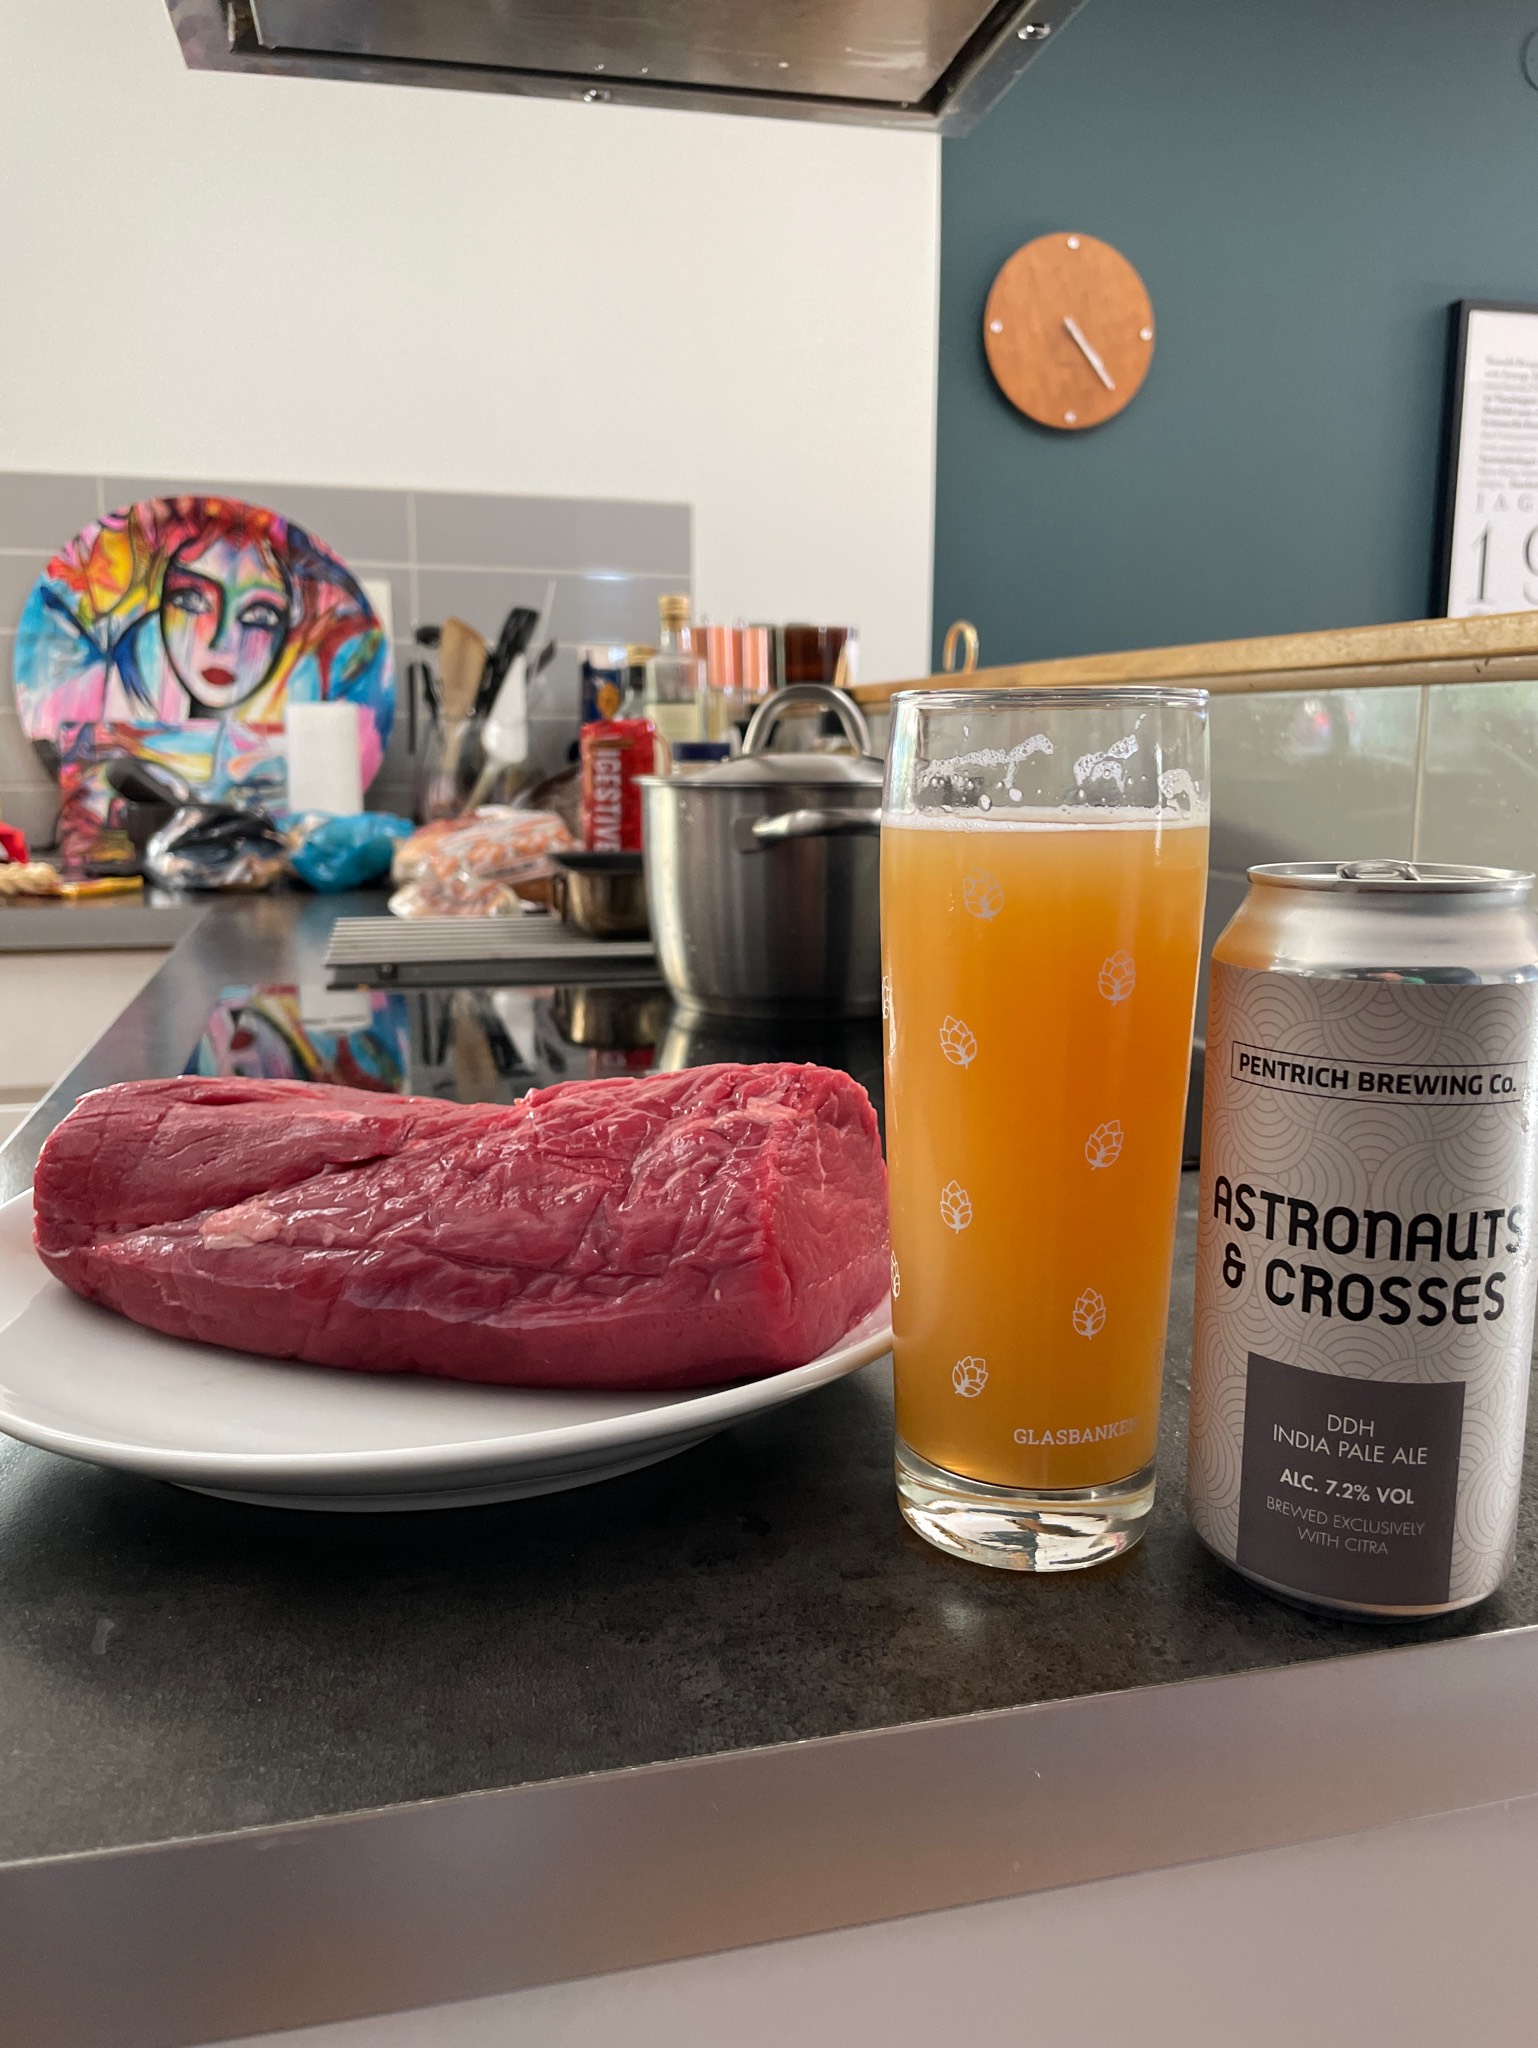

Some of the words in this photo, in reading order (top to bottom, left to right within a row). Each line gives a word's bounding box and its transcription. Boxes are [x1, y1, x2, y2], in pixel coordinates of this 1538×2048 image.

[1239, 1052, 1349, 1090] PENTRICH
[1357, 1071, 1483, 1096] BREWING
[1488, 1073, 1517, 1094] Co.
[1222, 1242, 1246, 1289] &
[1265, 1258, 1507, 1327] CROSSES
[1272, 1423, 1331, 1456] INDIA
[1338, 1440, 1385, 1464] PALE
[1391, 1447, 1428, 1465] ALE
[1326, 1413, 1375, 1438] DDH
[1279, 1467, 1319, 1493] ALC.
[1325, 1479, 1371, 1502] 7.2%
[1376, 1486, 1415, 1505] VOL
[1266, 1495, 1328, 1525] BREWED
[1333, 1515, 1426, 1536] EXCLUSIVELY
[1298, 1526, 1339, 1549] WITH
[1344, 1537, 1389, 1556] CITRA
